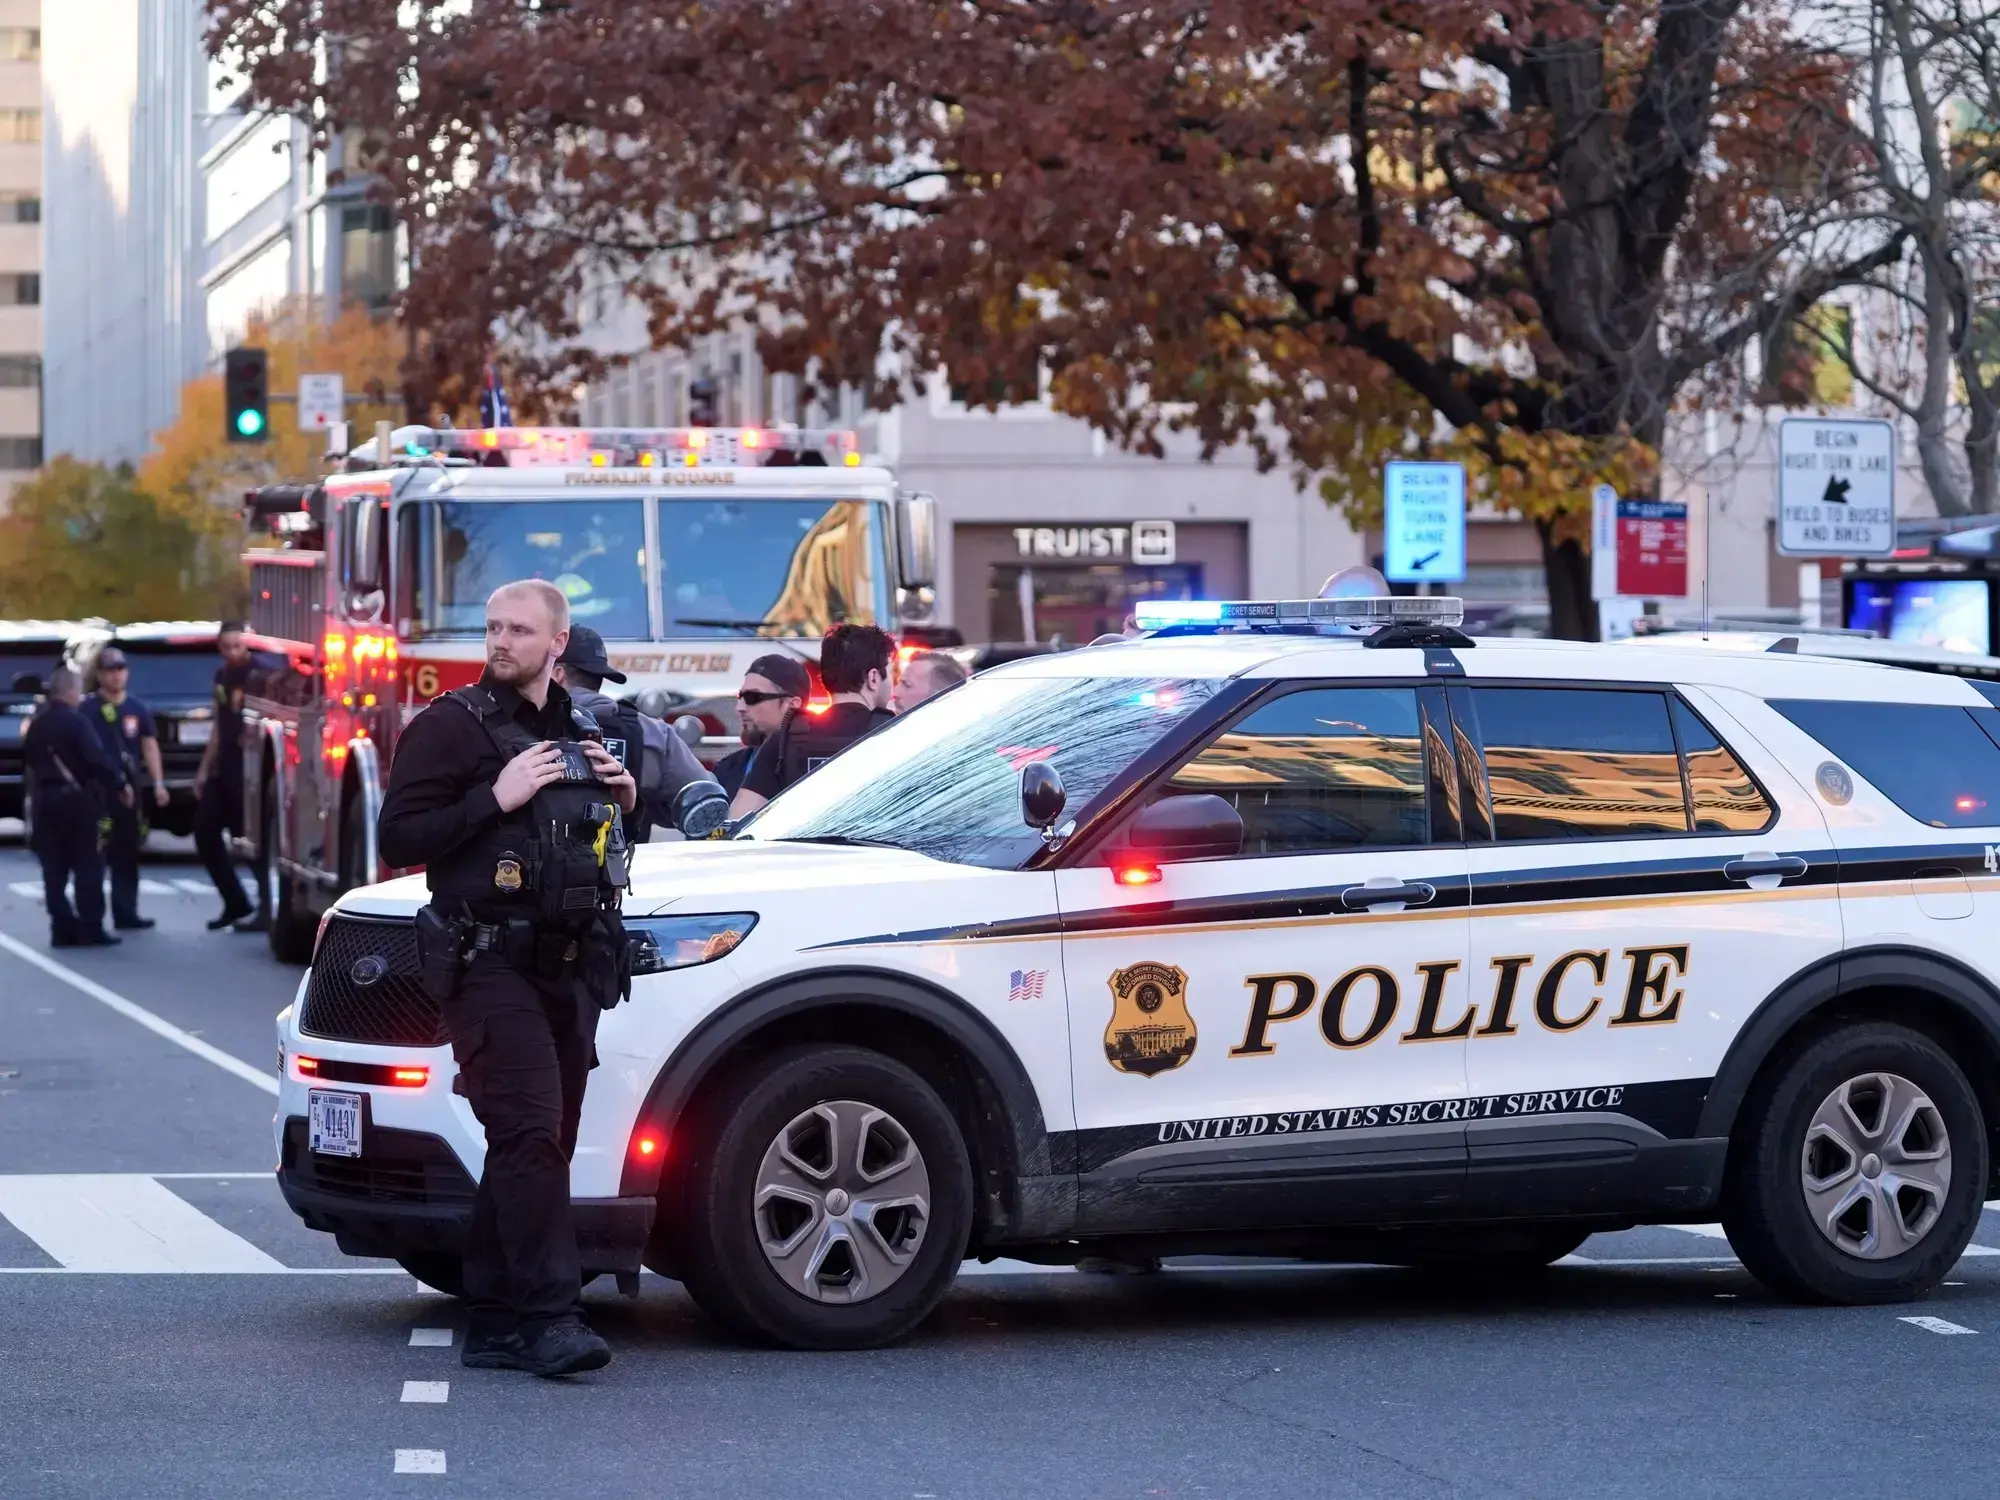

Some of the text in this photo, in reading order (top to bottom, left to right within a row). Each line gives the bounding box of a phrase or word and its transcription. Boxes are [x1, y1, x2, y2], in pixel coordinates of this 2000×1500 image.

[1813, 430, 1858, 447] BEGIN
[1785, 452, 1888, 472] RIGHT TURN LANE
[565, 472, 736, 485] FRANKLIN SQUARE
[1402, 472, 1450, 487] BEGIN
[1402, 490, 1448, 505] RIGHT
[1405, 510, 1448, 525] TURN
[1784, 506, 1890, 524] YIELD TO BUSES
[1012, 527, 1129, 557] TRUIST
[1402, 529, 1445, 544] LANE
[1803, 525, 1871, 542] AND BIKES
[1248, 605, 1275, 616] SERVICE
[1152, 966, 1172, 978] SERVICE
[1122, 973, 1176, 997] UNIFORMED DIVISION
[1227, 943, 1691, 1058] POLICE
[1157, 1086, 1625, 1143] UNITED STATES SECRET SERVICE
[325, 1107, 356, 1140] 4143Y
